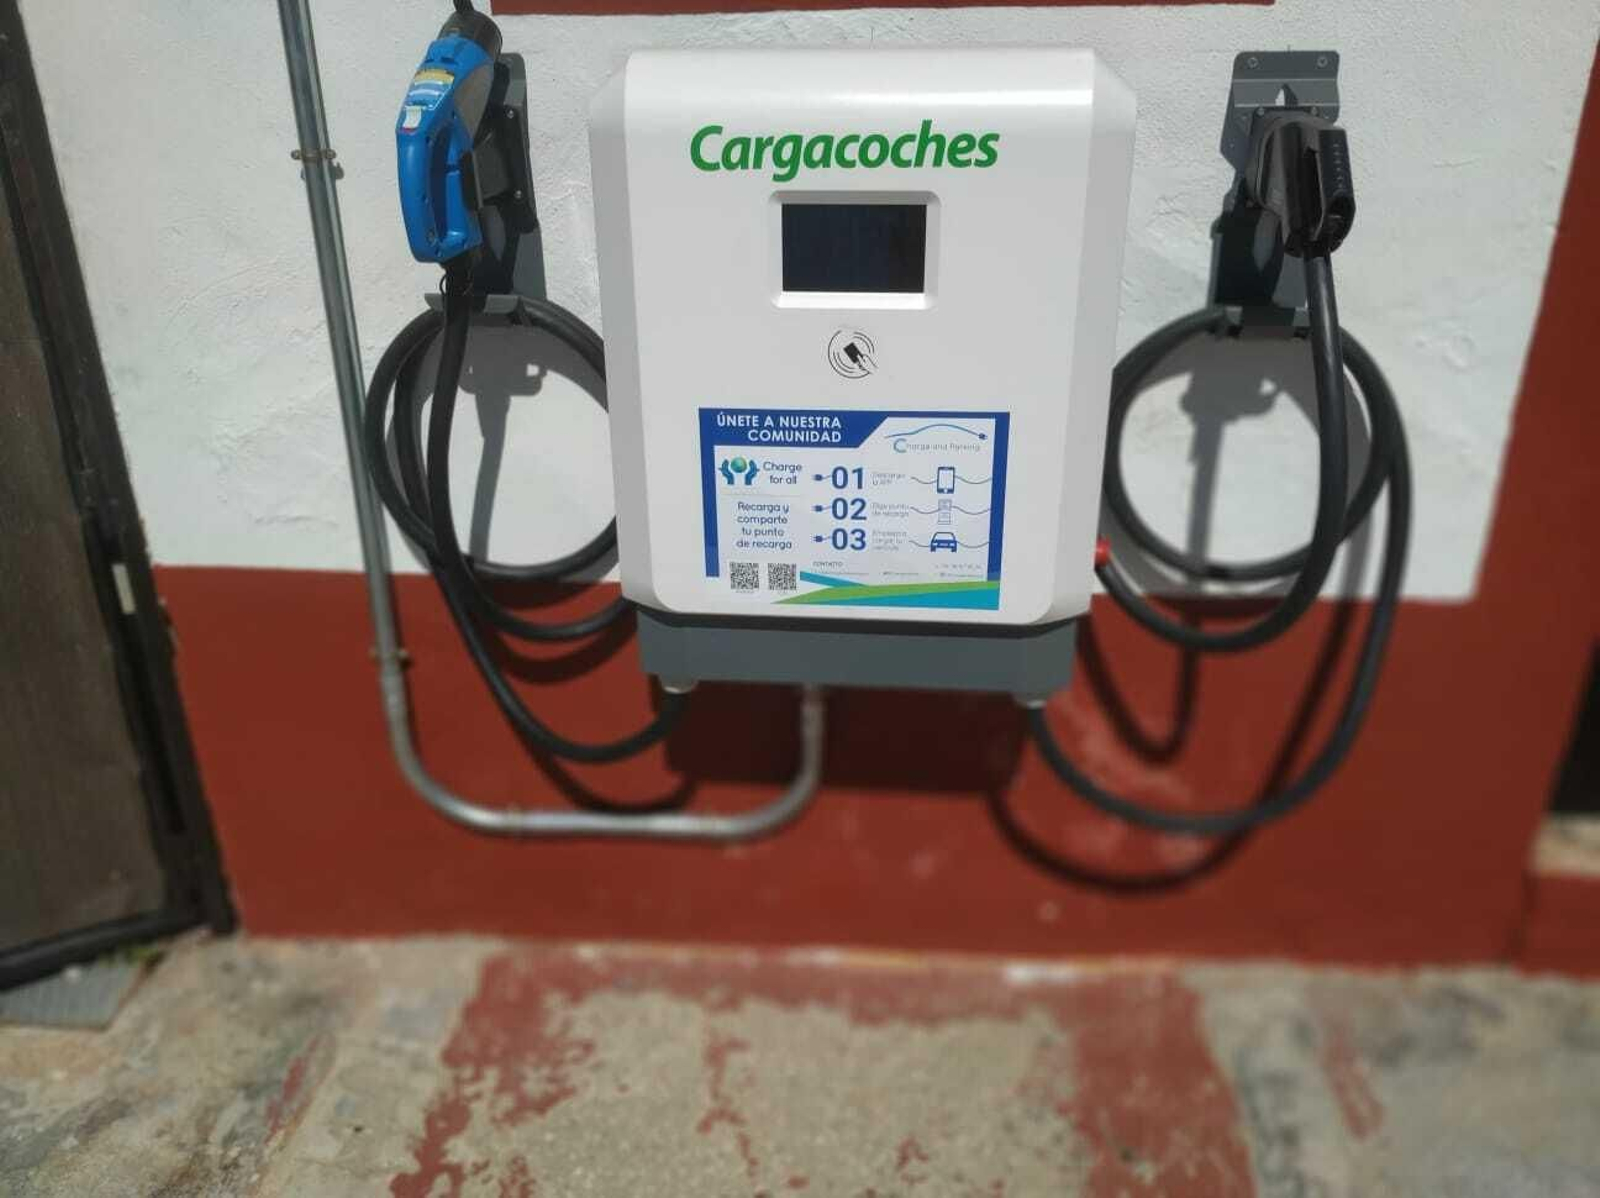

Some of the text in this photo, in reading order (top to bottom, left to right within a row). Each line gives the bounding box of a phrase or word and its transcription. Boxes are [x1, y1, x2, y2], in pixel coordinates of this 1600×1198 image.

[690, 118, 1001, 183] Cargacoches
[716, 411, 842, 429] ÚNETE A NUESTRA
[747, 429, 842, 443] COMUNIDAD
[762, 461, 803, 474] Charge
[769, 475, 797, 485] for all
[831, 465, 864, 490] 01
[737, 501, 790, 514] Recarga y
[831, 497, 867, 521] 02
[737, 515, 788, 526] comparte
[741, 527, 785, 538] tu punto
[831, 527, 866, 551] 03
[736, 540, 792, 550] de recarga
